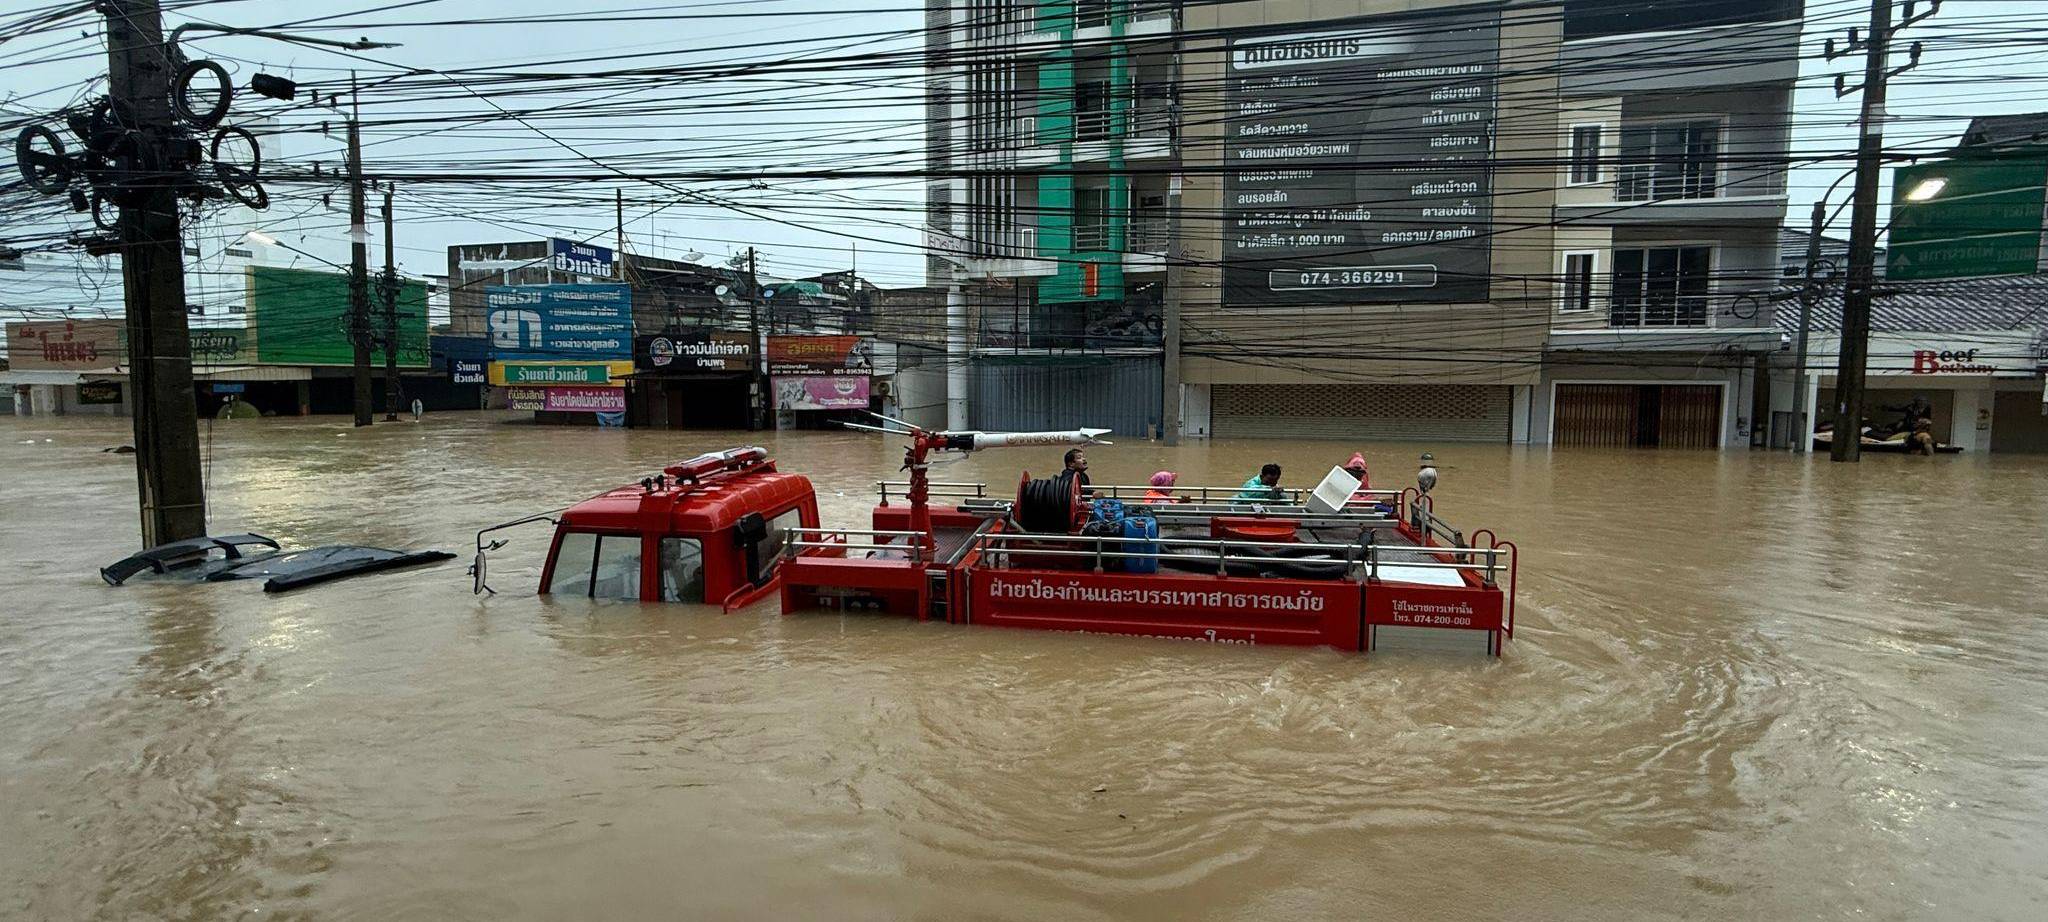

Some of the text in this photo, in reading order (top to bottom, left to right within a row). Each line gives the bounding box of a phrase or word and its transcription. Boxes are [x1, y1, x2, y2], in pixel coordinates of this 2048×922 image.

[1430, 87, 1481, 100] เสริมจมก
[1411, 180, 1477, 195] เสริมหน้าอก
[1238, 190, 1287, 204] ลบรอยสัก
[1289, 235, 1320, 247] 1,000
[1300, 272, 1404, 285] 074-366291
[490, 309, 542, 349] ยา
[989, 578, 1325, 612] ฝ่ายป้องกันและบรรเทาสาธารณภัย
[1392, 599, 1474, 615] ใช้ในราชการเท่านั้น
[1393, 611, 1471, 626] โทร. 074-200-000
